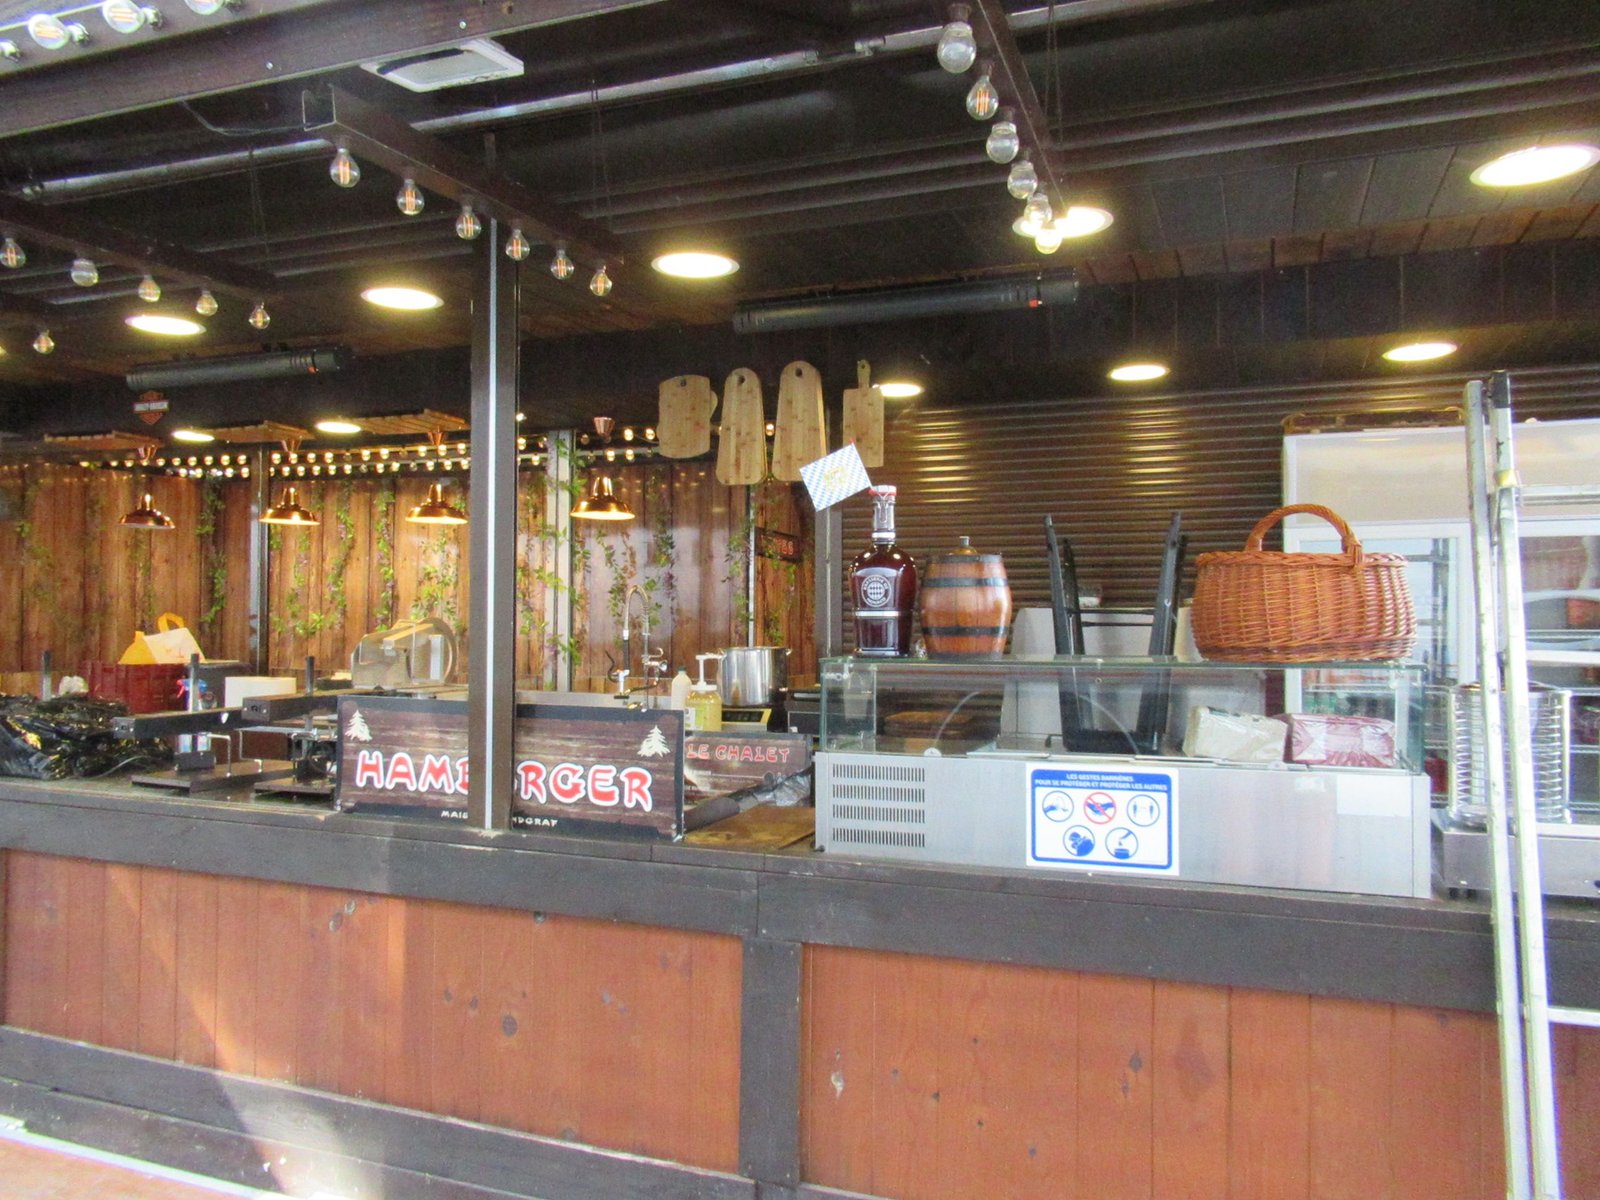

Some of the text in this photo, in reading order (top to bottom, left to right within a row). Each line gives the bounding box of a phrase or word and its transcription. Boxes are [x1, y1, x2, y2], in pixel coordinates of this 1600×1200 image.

[686, 743, 791, 763] LE CHALET
[356, 750, 653, 812] HAMRGER
[441, 810, 468, 819] MAIS
